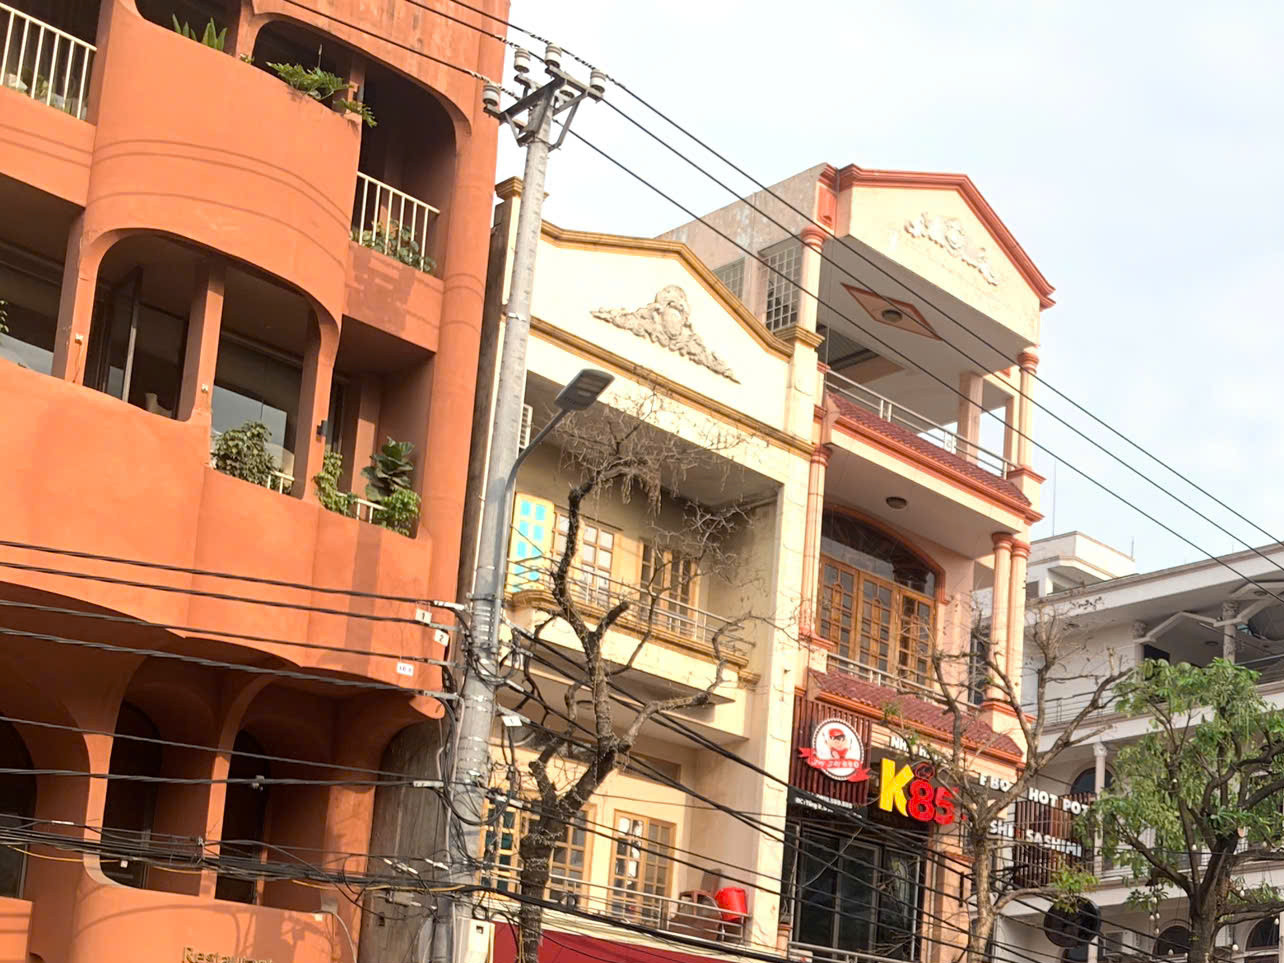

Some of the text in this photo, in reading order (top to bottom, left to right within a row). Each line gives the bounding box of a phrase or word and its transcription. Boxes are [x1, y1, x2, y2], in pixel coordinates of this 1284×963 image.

[1029, 786, 1058, 808] HOT
[1062, 799, 1089, 816] POT
[1025, 828, 1082, 858] SASHIMI
